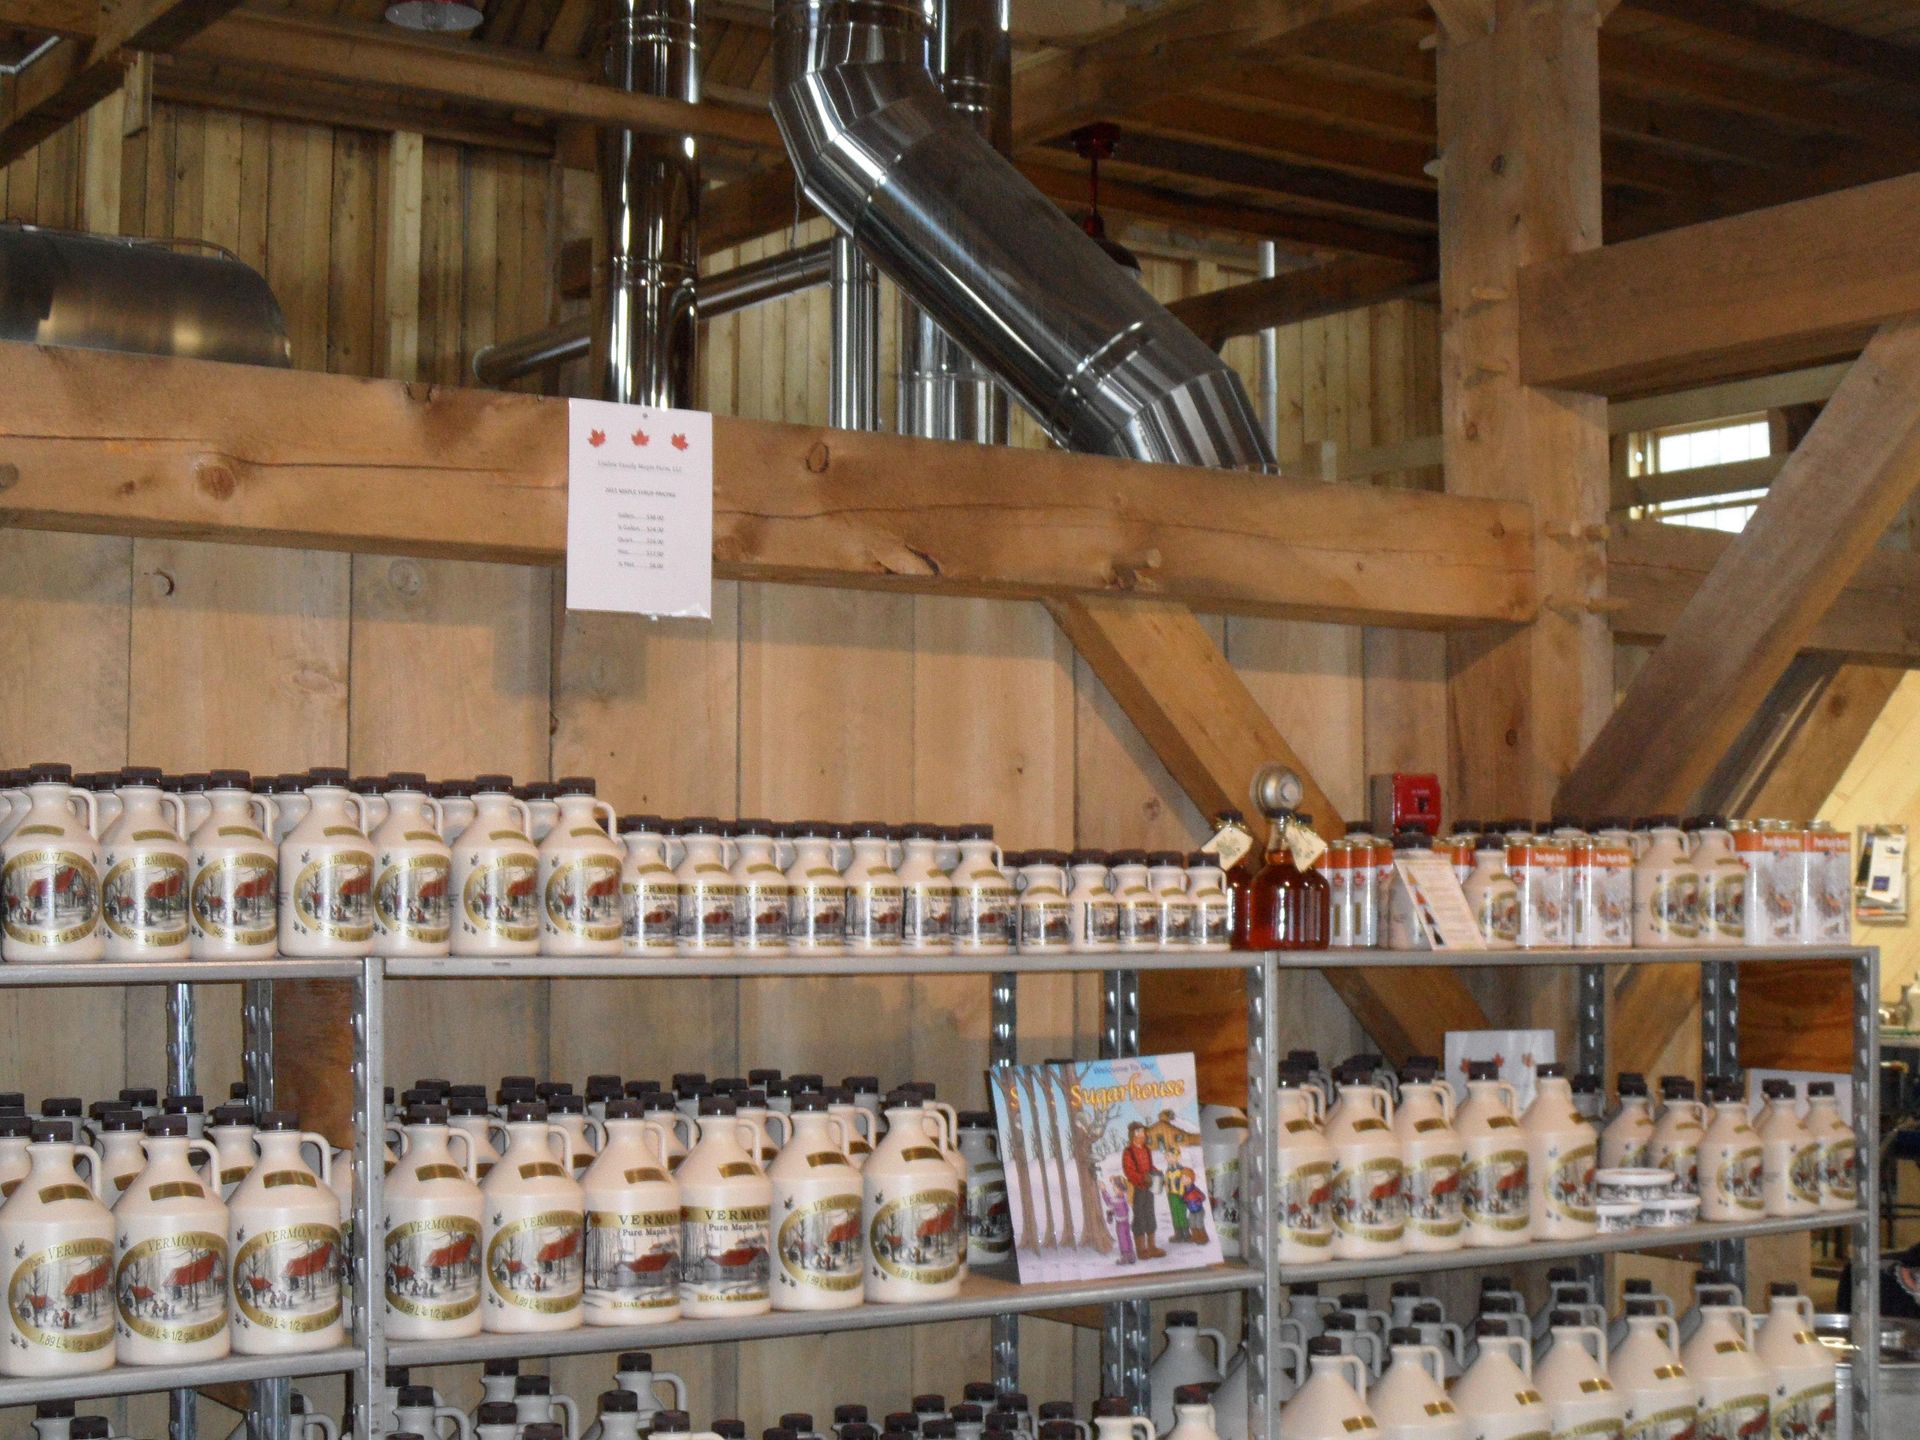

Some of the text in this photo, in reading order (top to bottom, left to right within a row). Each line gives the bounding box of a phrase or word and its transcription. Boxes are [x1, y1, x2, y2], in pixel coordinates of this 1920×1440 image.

[1093, 1065, 1129, 1074] Welcome
[1070, 1072, 1185, 1110] Sugarhouse
[645, 1227, 667, 1237] Maple
[708, 1223, 729, 1231] Pure
[731, 1222, 754, 1232] Maple
[147, 1235, 203, 1252] VERMONT
[171, 1329, 183, 1341] 1/2
